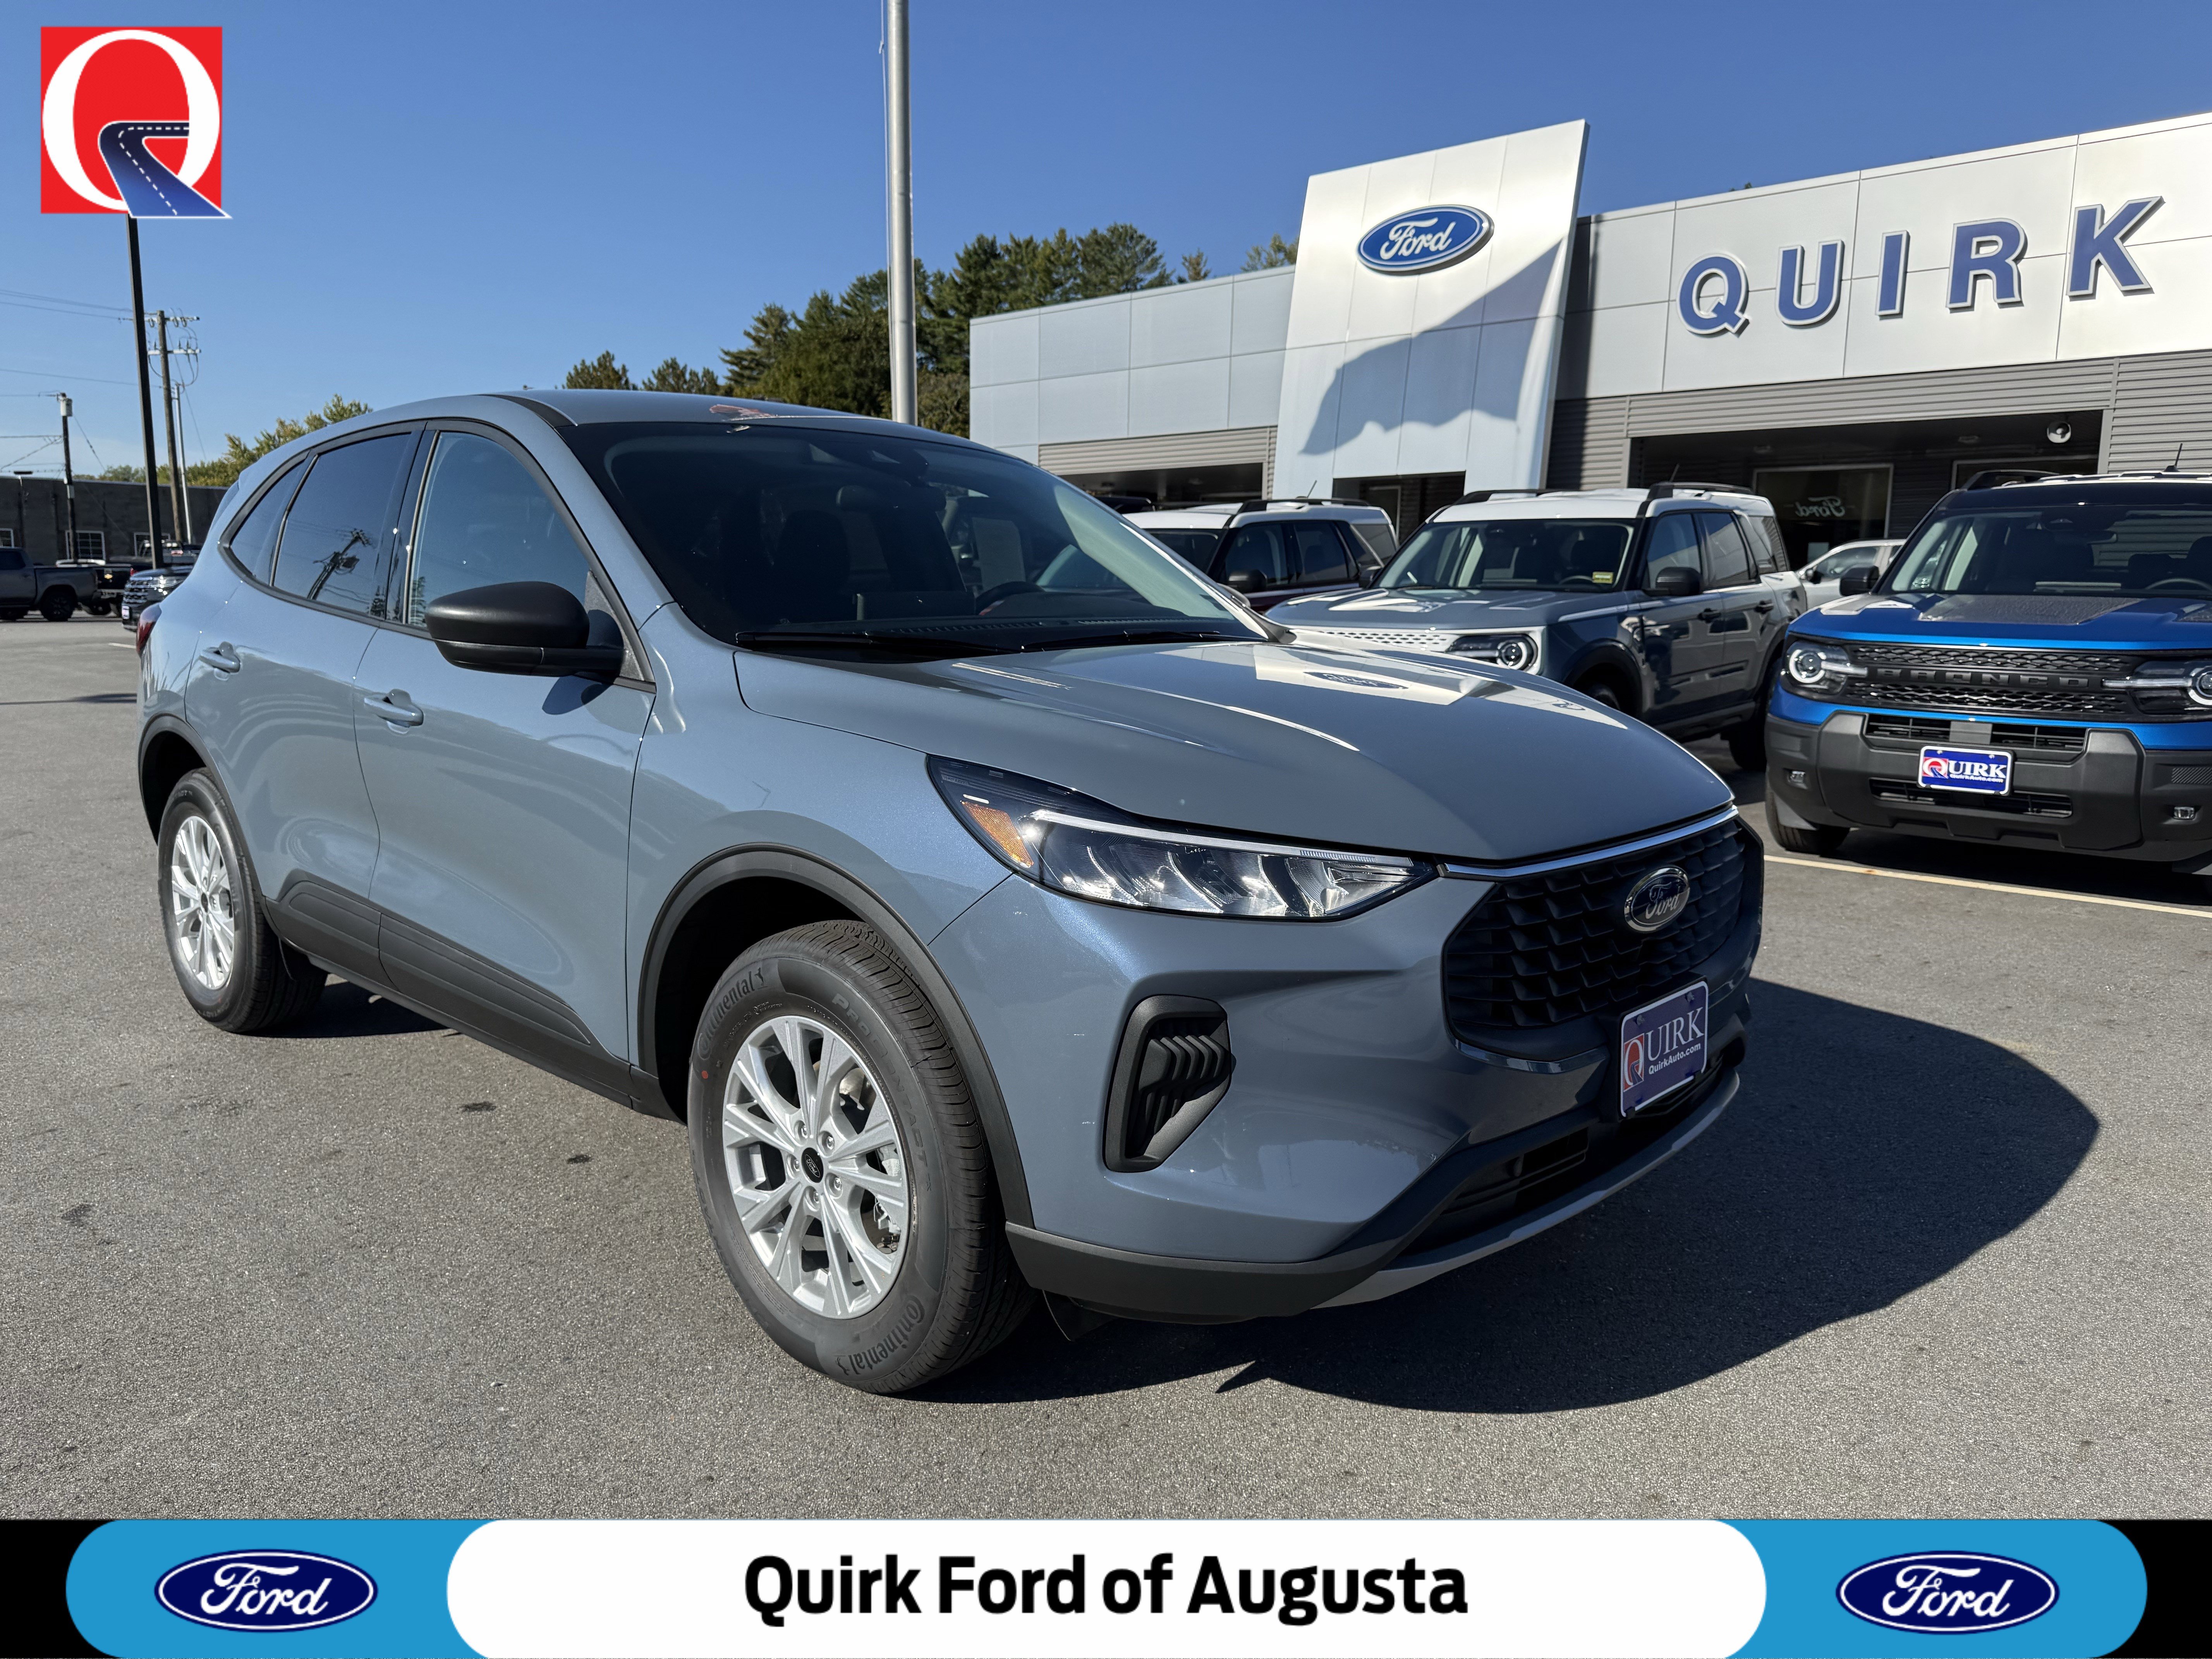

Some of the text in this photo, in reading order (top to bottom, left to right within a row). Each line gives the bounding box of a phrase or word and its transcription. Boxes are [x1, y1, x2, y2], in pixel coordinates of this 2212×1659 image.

[1380, 217, 1456, 260] Ford
[1677, 196, 2165, 336] QUIRK
[1877, 668, 2089, 688] BRONCO
[1922, 757, 2007, 779] QUIRK
[1949, 773, 2004, 783] QuirkAuto.com
[1645, 880, 1681, 919] Ford
[1624, 1006, 1705, 1087] QUIRK
[1648, 1042, 1701, 1075] QuirkAuto.com
[806, 1158, 817, 1174] Ford
[848, 1295, 926, 1375] Continental
